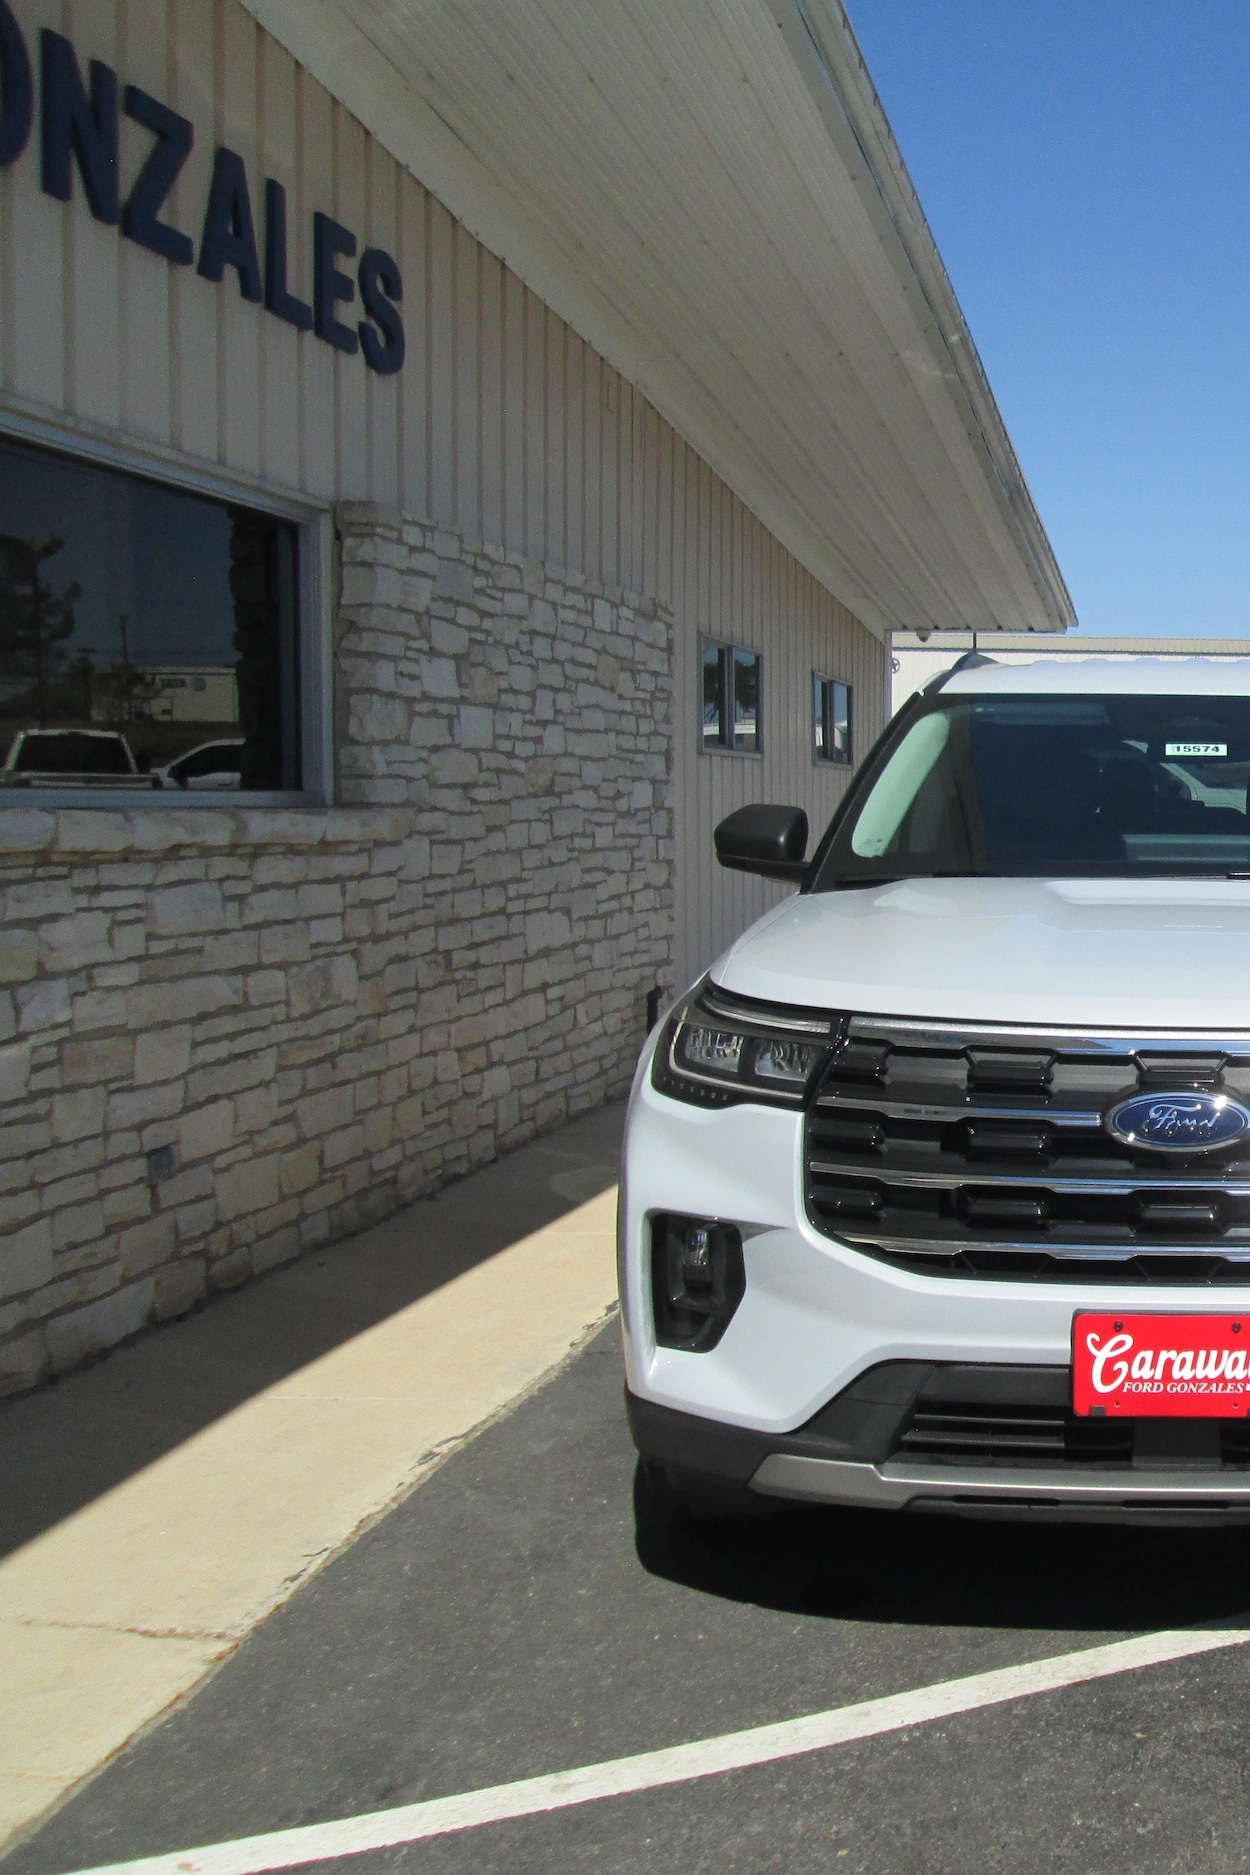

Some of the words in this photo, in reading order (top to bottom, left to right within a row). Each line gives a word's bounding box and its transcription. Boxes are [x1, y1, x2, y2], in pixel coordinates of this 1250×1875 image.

[1173, 745, 1220, 753] 15574
[1122, 1382, 1164, 1393] FORD
[1166, 1382, 1244, 1394] GONZALES
